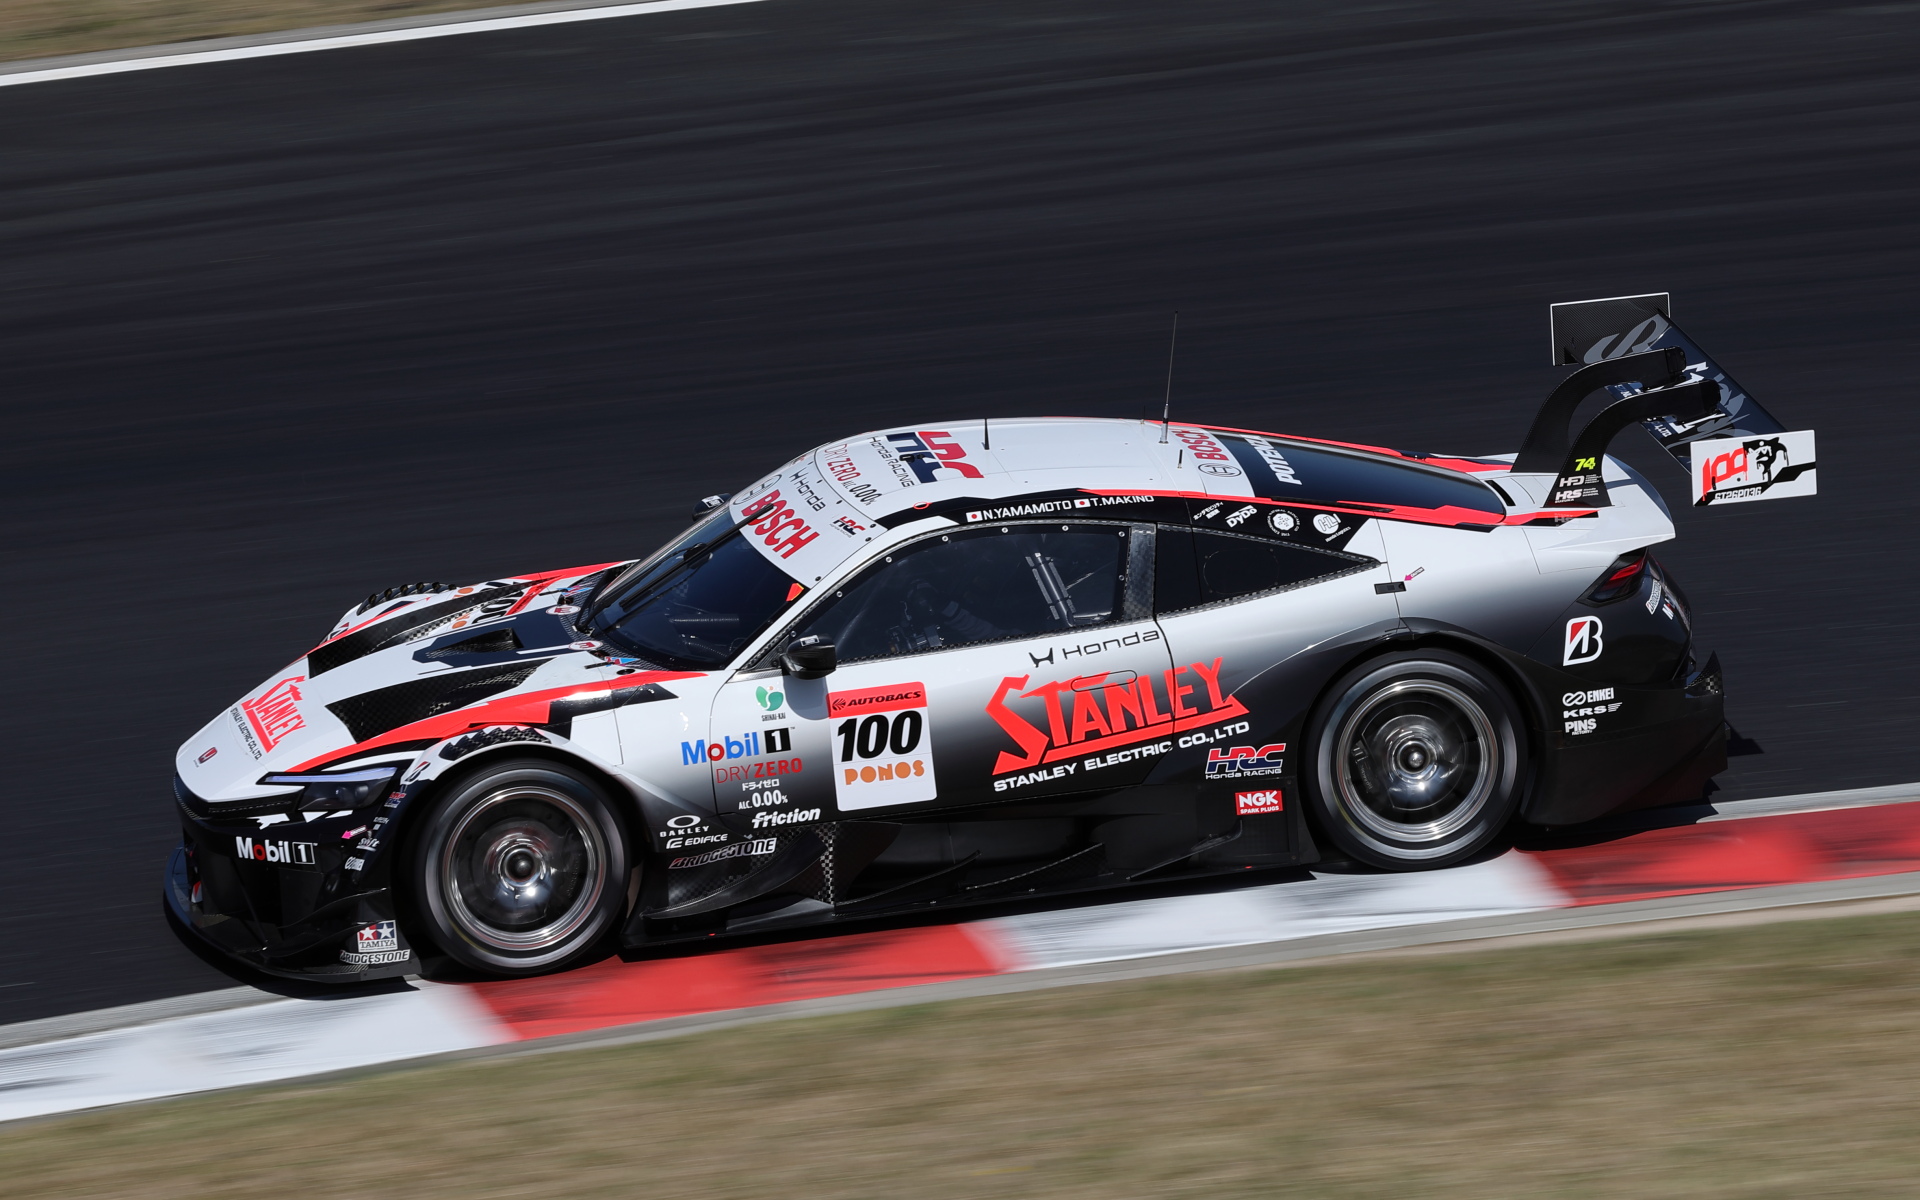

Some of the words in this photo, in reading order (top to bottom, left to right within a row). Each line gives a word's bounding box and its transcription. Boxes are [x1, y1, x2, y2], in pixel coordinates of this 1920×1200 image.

[885, 456, 915, 488] RACING
[1575, 457, 1596, 471] 74
[793, 476, 826, 512] Honda
[1089, 494, 1155, 507] T.MAKINO
[1555, 488, 1583, 501] HRS
[982, 499, 1072, 521] N.YAMAMOTO
[741, 489, 820, 560] BOSCH
[1062, 629, 1160, 660] Honda
[847, 690, 922, 707] AUTOBACS
[1587, 687, 1615, 703] ENKEI
[241, 675, 307, 754] STANLEY
[985, 657, 1250, 776] STANLEY
[1563, 705, 1607, 719] KRS
[1564, 718, 1597, 733] PINS
[837, 710, 922, 762] 100
[680, 731, 760, 766] Mobil
[1205, 742, 1287, 774] HRC
[844, 759, 925, 786] PONOS
[993, 762, 1078, 792] STANLEY
[1084, 740, 1173, 771] ELECTRIC
[1205, 772, 1242, 780] Honda
[1243, 768, 1282, 777] RACING
[742, 778, 780, 792] ドライゼロ
[1238, 790, 1279, 808] NGK
[751, 808, 821, 829] friction
[1240, 807, 1260, 815] SPARK
[1260, 805, 1280, 813] PLUGS
[659, 825, 710, 838] OAKLEY
[684, 833, 729, 846] EDIFICE
[235, 836, 291, 863] Mobil
[668, 838, 777, 869] BRIDGESTONE
[359, 939, 396, 949] TAMIYA
[340, 949, 411, 965] BRIDGESTONE
